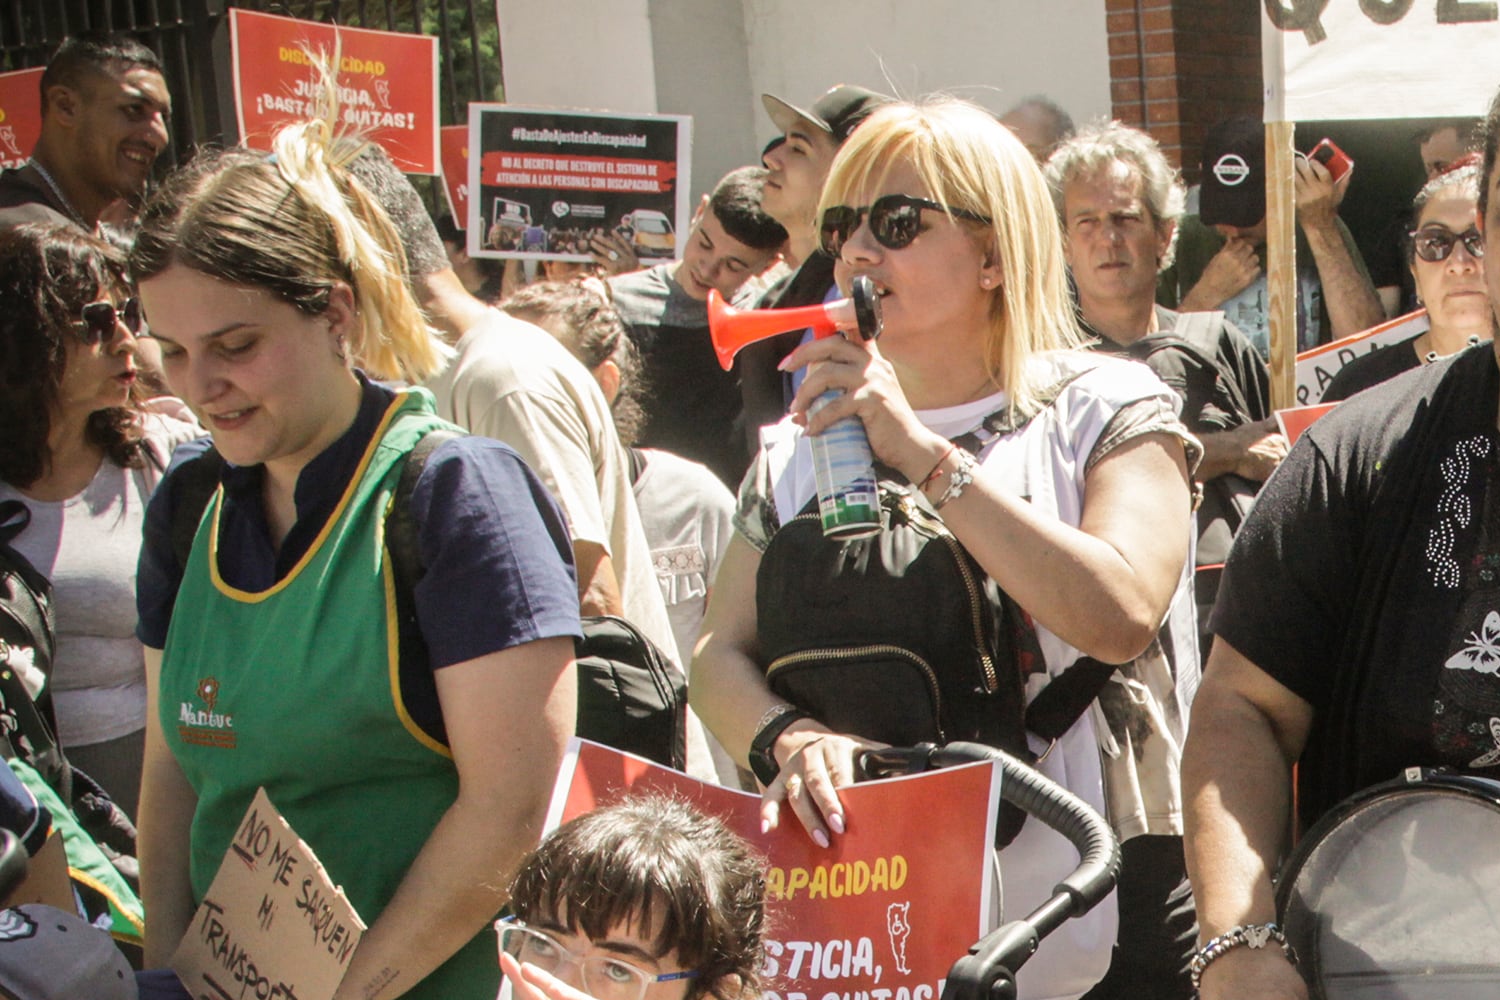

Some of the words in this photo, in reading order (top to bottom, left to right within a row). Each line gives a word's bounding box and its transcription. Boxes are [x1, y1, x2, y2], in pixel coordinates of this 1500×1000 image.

[279, 46, 386, 77] DISCCIDAD
[344, 108, 415, 130] QUITAS!
[511, 127, 647, 149] #BastaDeAjustesEnDiscapacidad
[502, 156, 512, 169] NO
[513, 157, 522, 170] AL
[523, 157, 554, 171] DECRETO
[555, 158, 569, 172] QUE
[570, 159, 606, 174] DESTRUYE
[607, 162, 615, 174] EL
[616, 162, 647, 176] SISTEMA
[648, 164, 658, 177] DE
[532, 174, 538, 185] A
[538, 174, 553, 186] LAS
[553, 175, 590, 188] PERSONAS
[591, 177, 606, 189] CON
[239, 809, 270, 858] NO
[268, 838, 298, 888] ME
[295, 878, 355, 964] SAQUEN
[764, 855, 908, 901] APACIDAD
[762, 936, 883, 984] STICIA,
